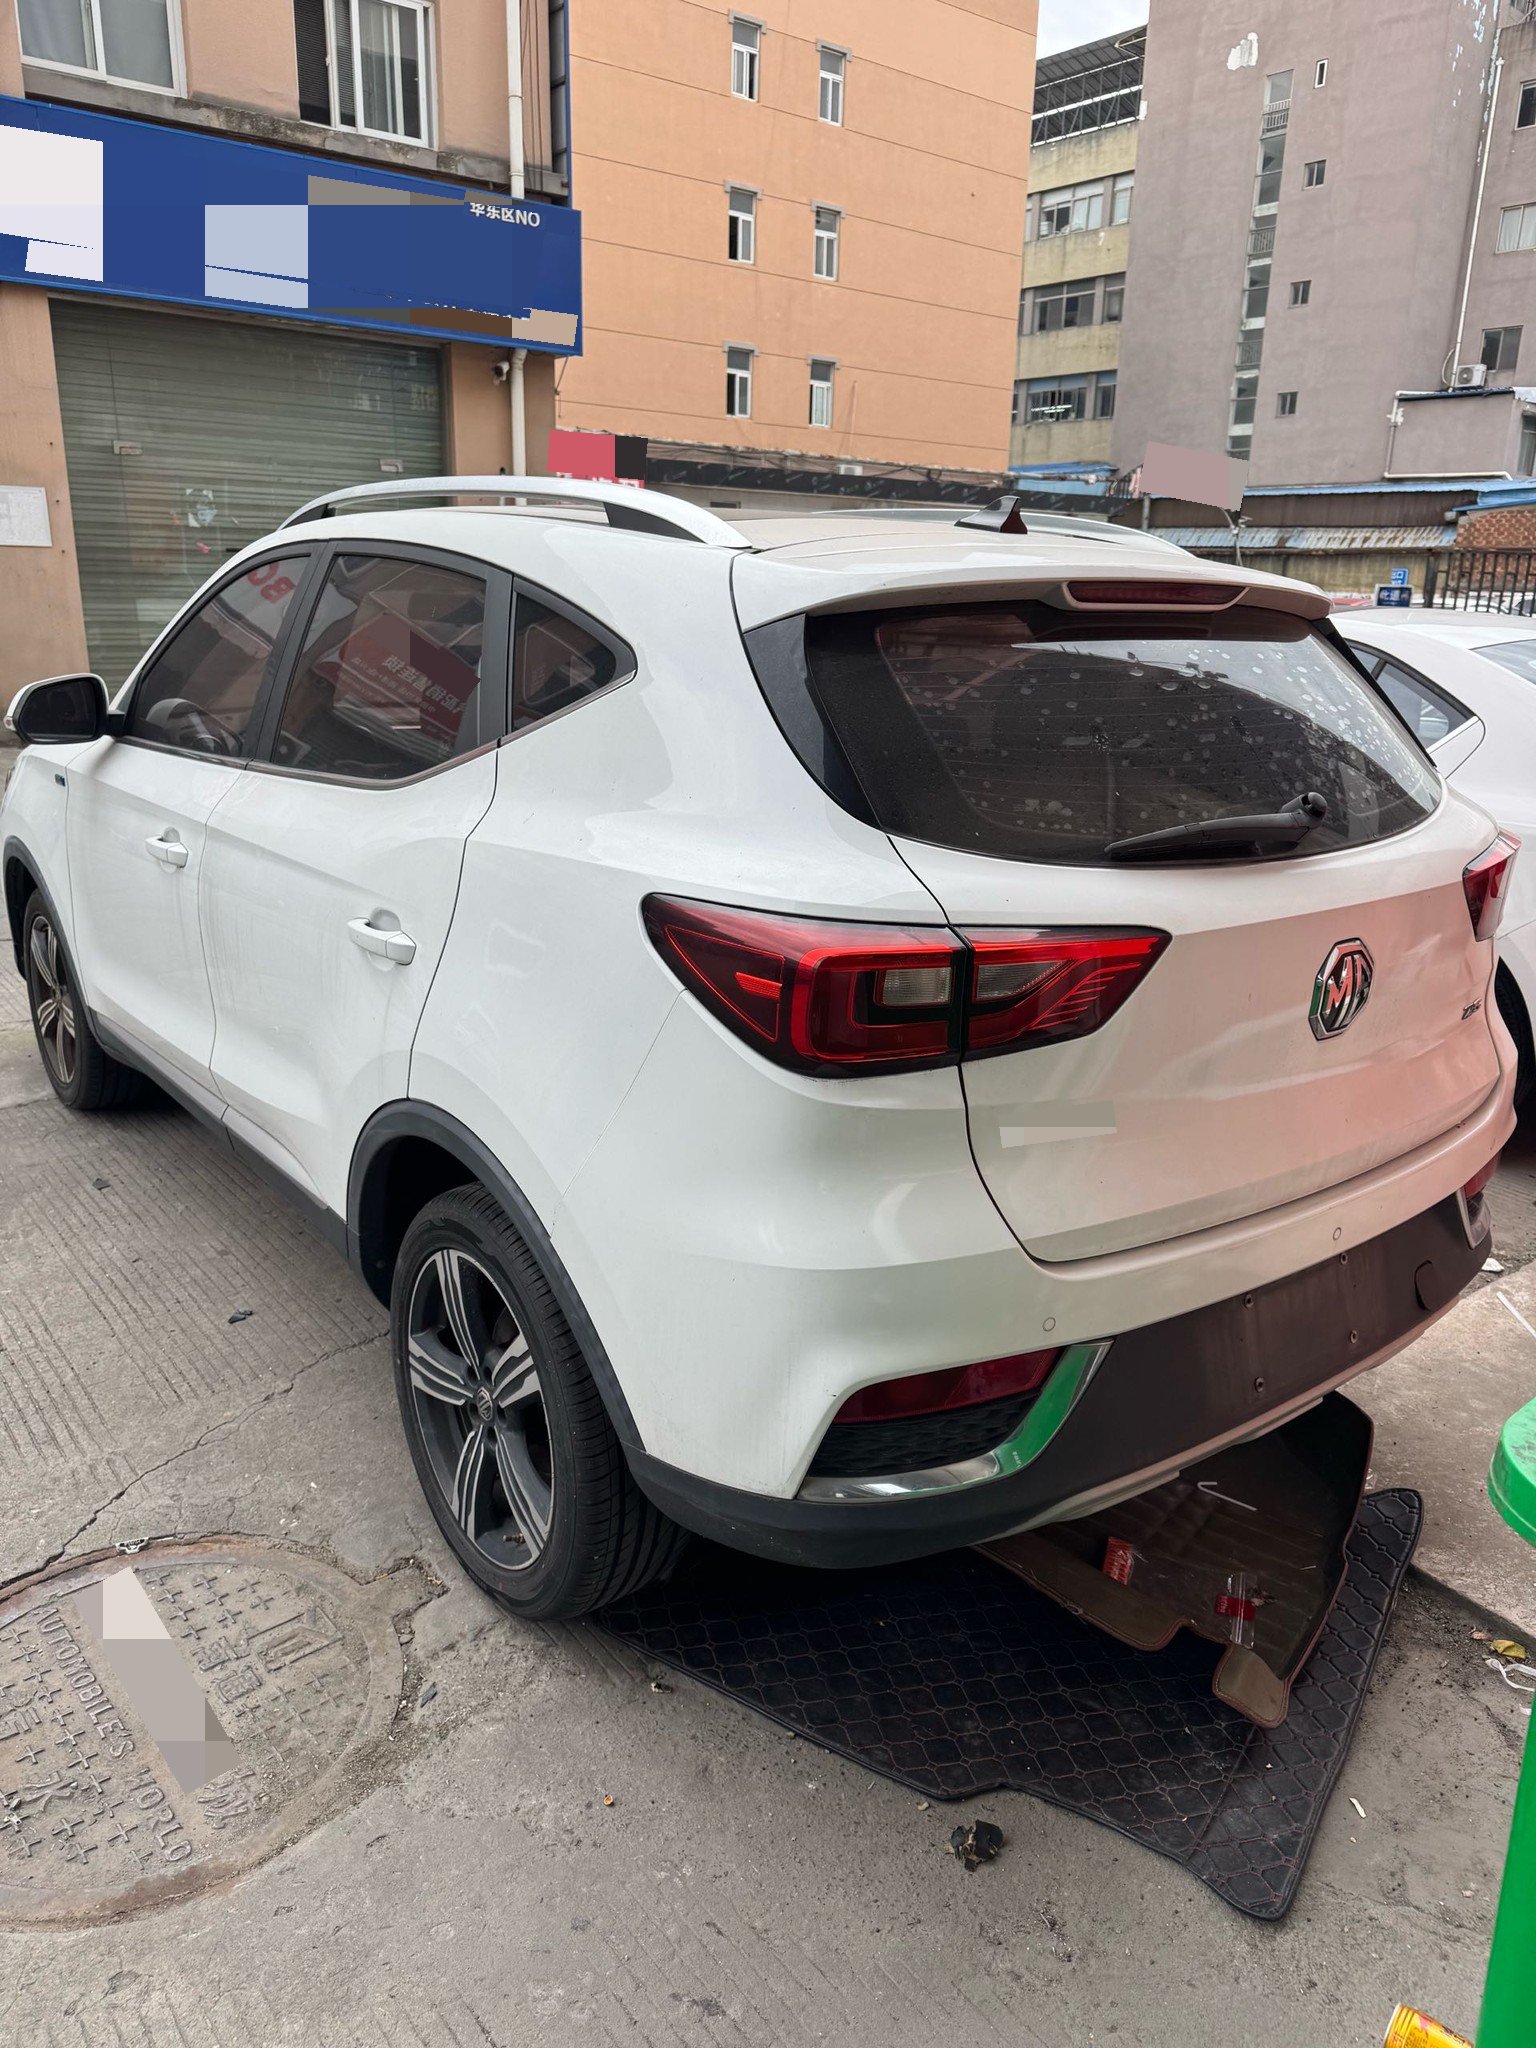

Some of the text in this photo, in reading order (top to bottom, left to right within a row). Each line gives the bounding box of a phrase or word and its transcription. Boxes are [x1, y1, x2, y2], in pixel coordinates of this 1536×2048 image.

[1321, 951, 1372, 1031] MG
[34, 1605, 192, 1862] AUTOMOBILE'S WORLD
